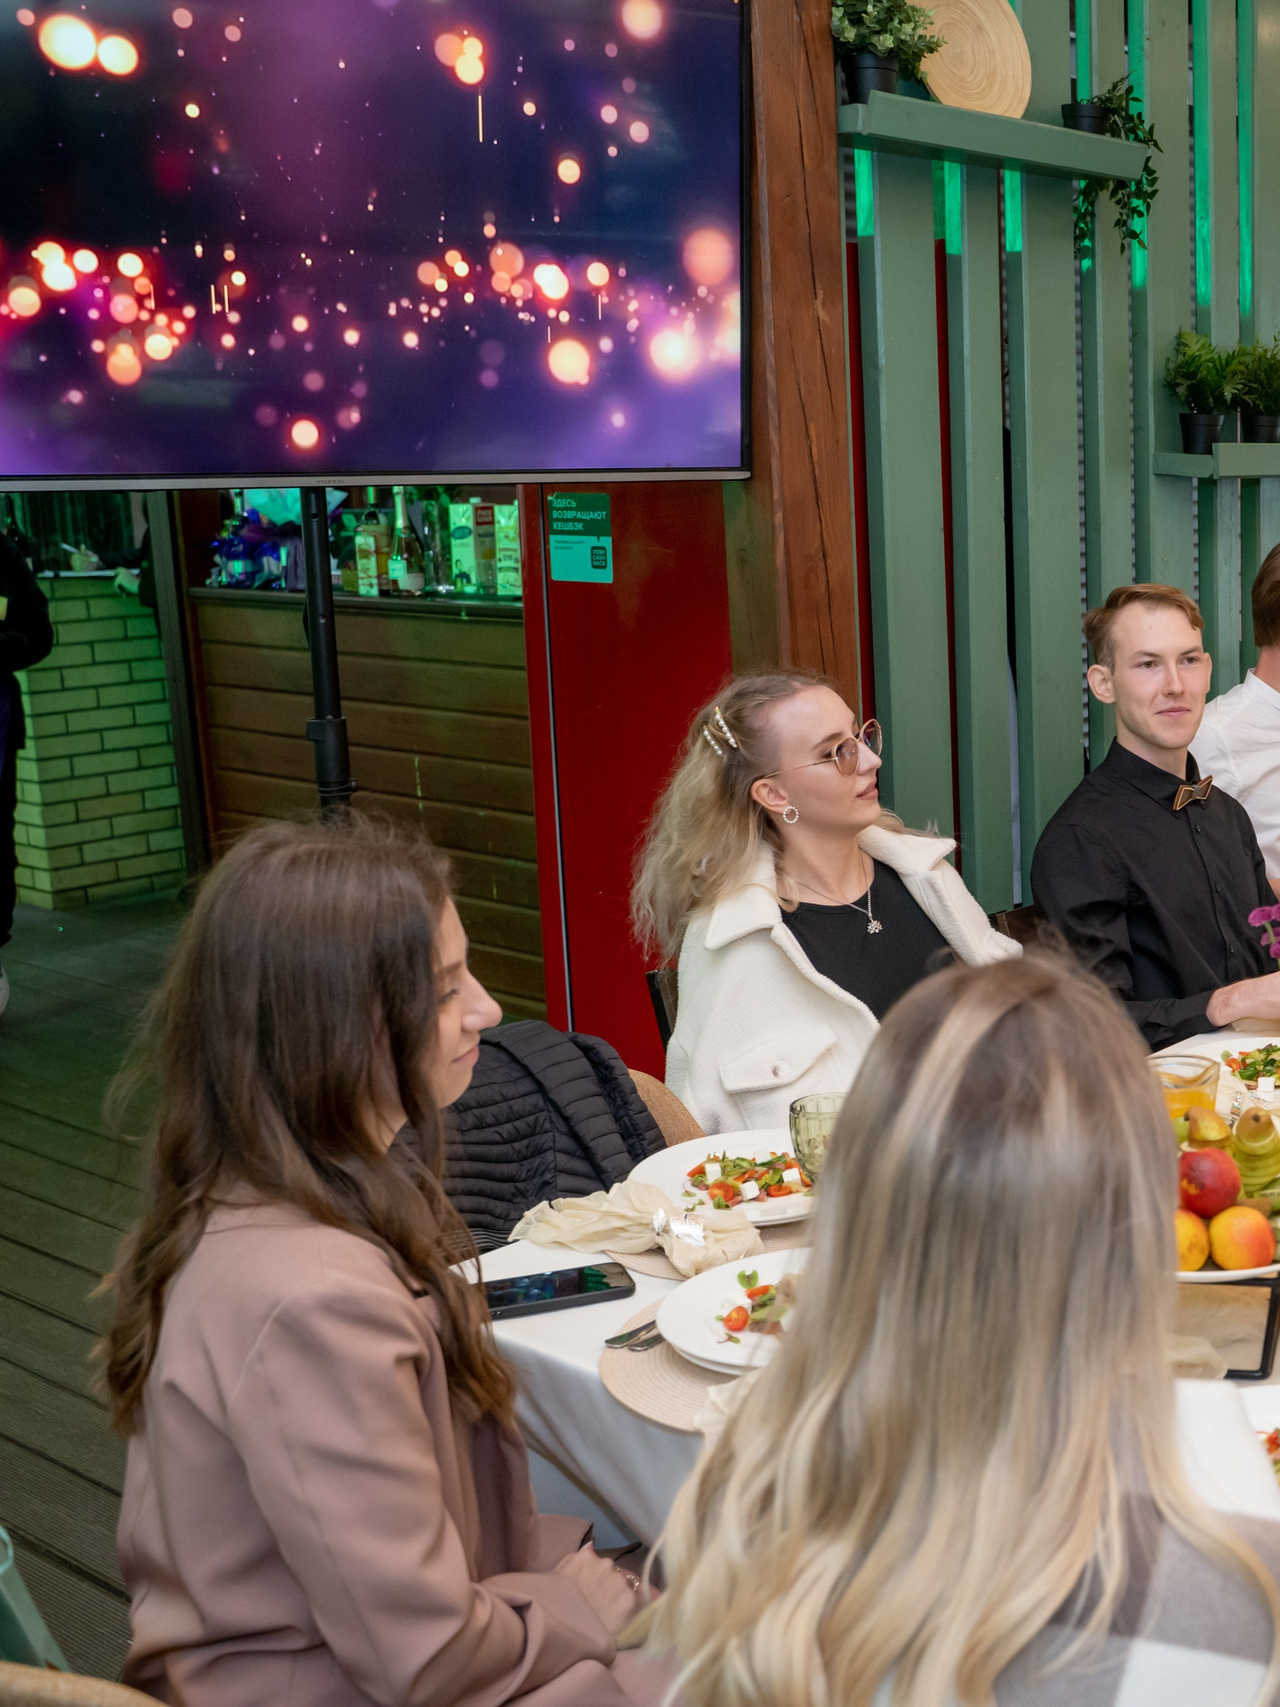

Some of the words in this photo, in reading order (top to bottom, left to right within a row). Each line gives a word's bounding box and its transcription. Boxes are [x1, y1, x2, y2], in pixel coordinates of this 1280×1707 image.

[553, 499, 576, 508] ЗДЕСЬ
[552, 510, 606, 520] ВОЗВРАЩАЮТ
[553, 522, 584, 531] КЕШБЭК
